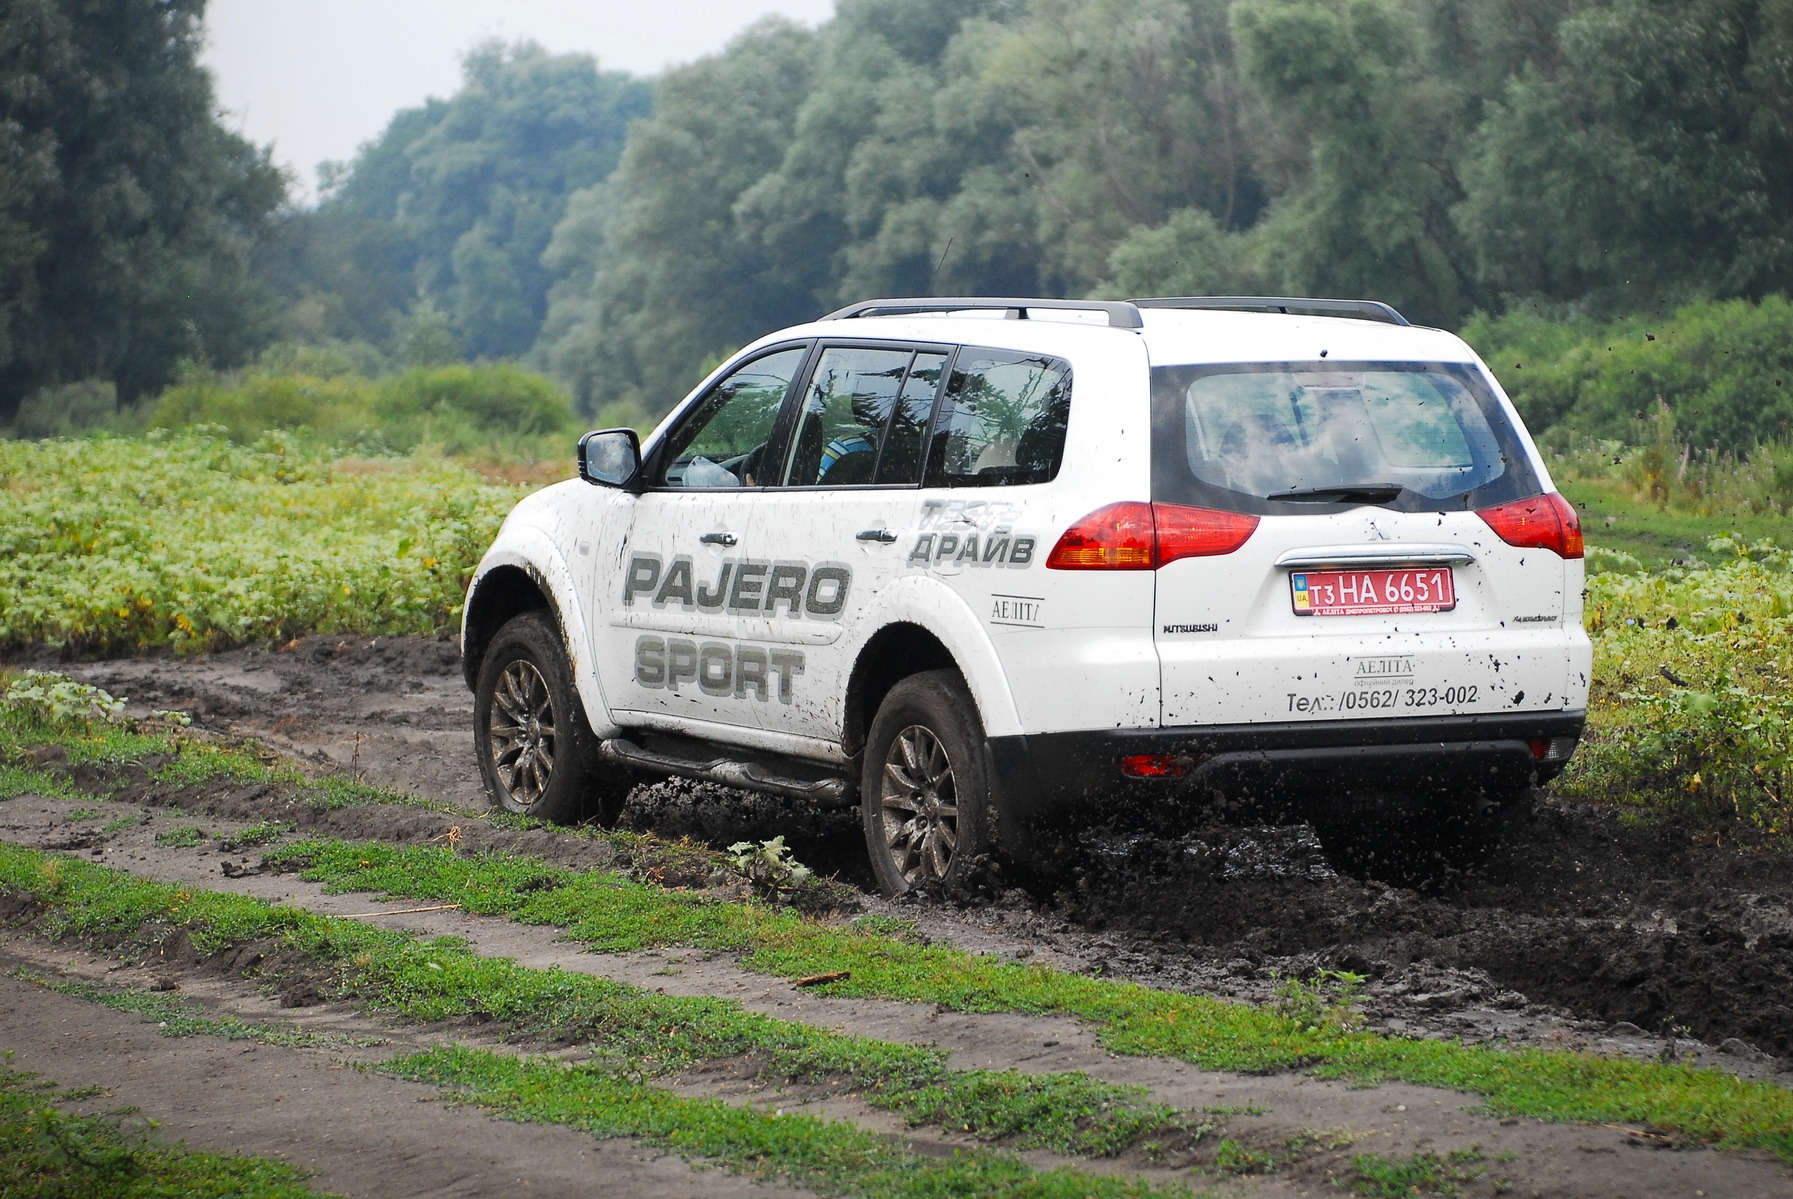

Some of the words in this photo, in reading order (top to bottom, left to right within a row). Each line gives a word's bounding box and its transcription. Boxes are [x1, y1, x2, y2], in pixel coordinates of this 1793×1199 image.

[906, 525, 1038, 569] ДРАЙВ
[621, 551, 853, 621] PAJERO
[1385, 572, 1444, 602] 6651
[1163, 623, 1218, 634] MITSUBISHI
[634, 635, 805, 705] SPORT
[1405, 685, 1478, 707] 323-002
